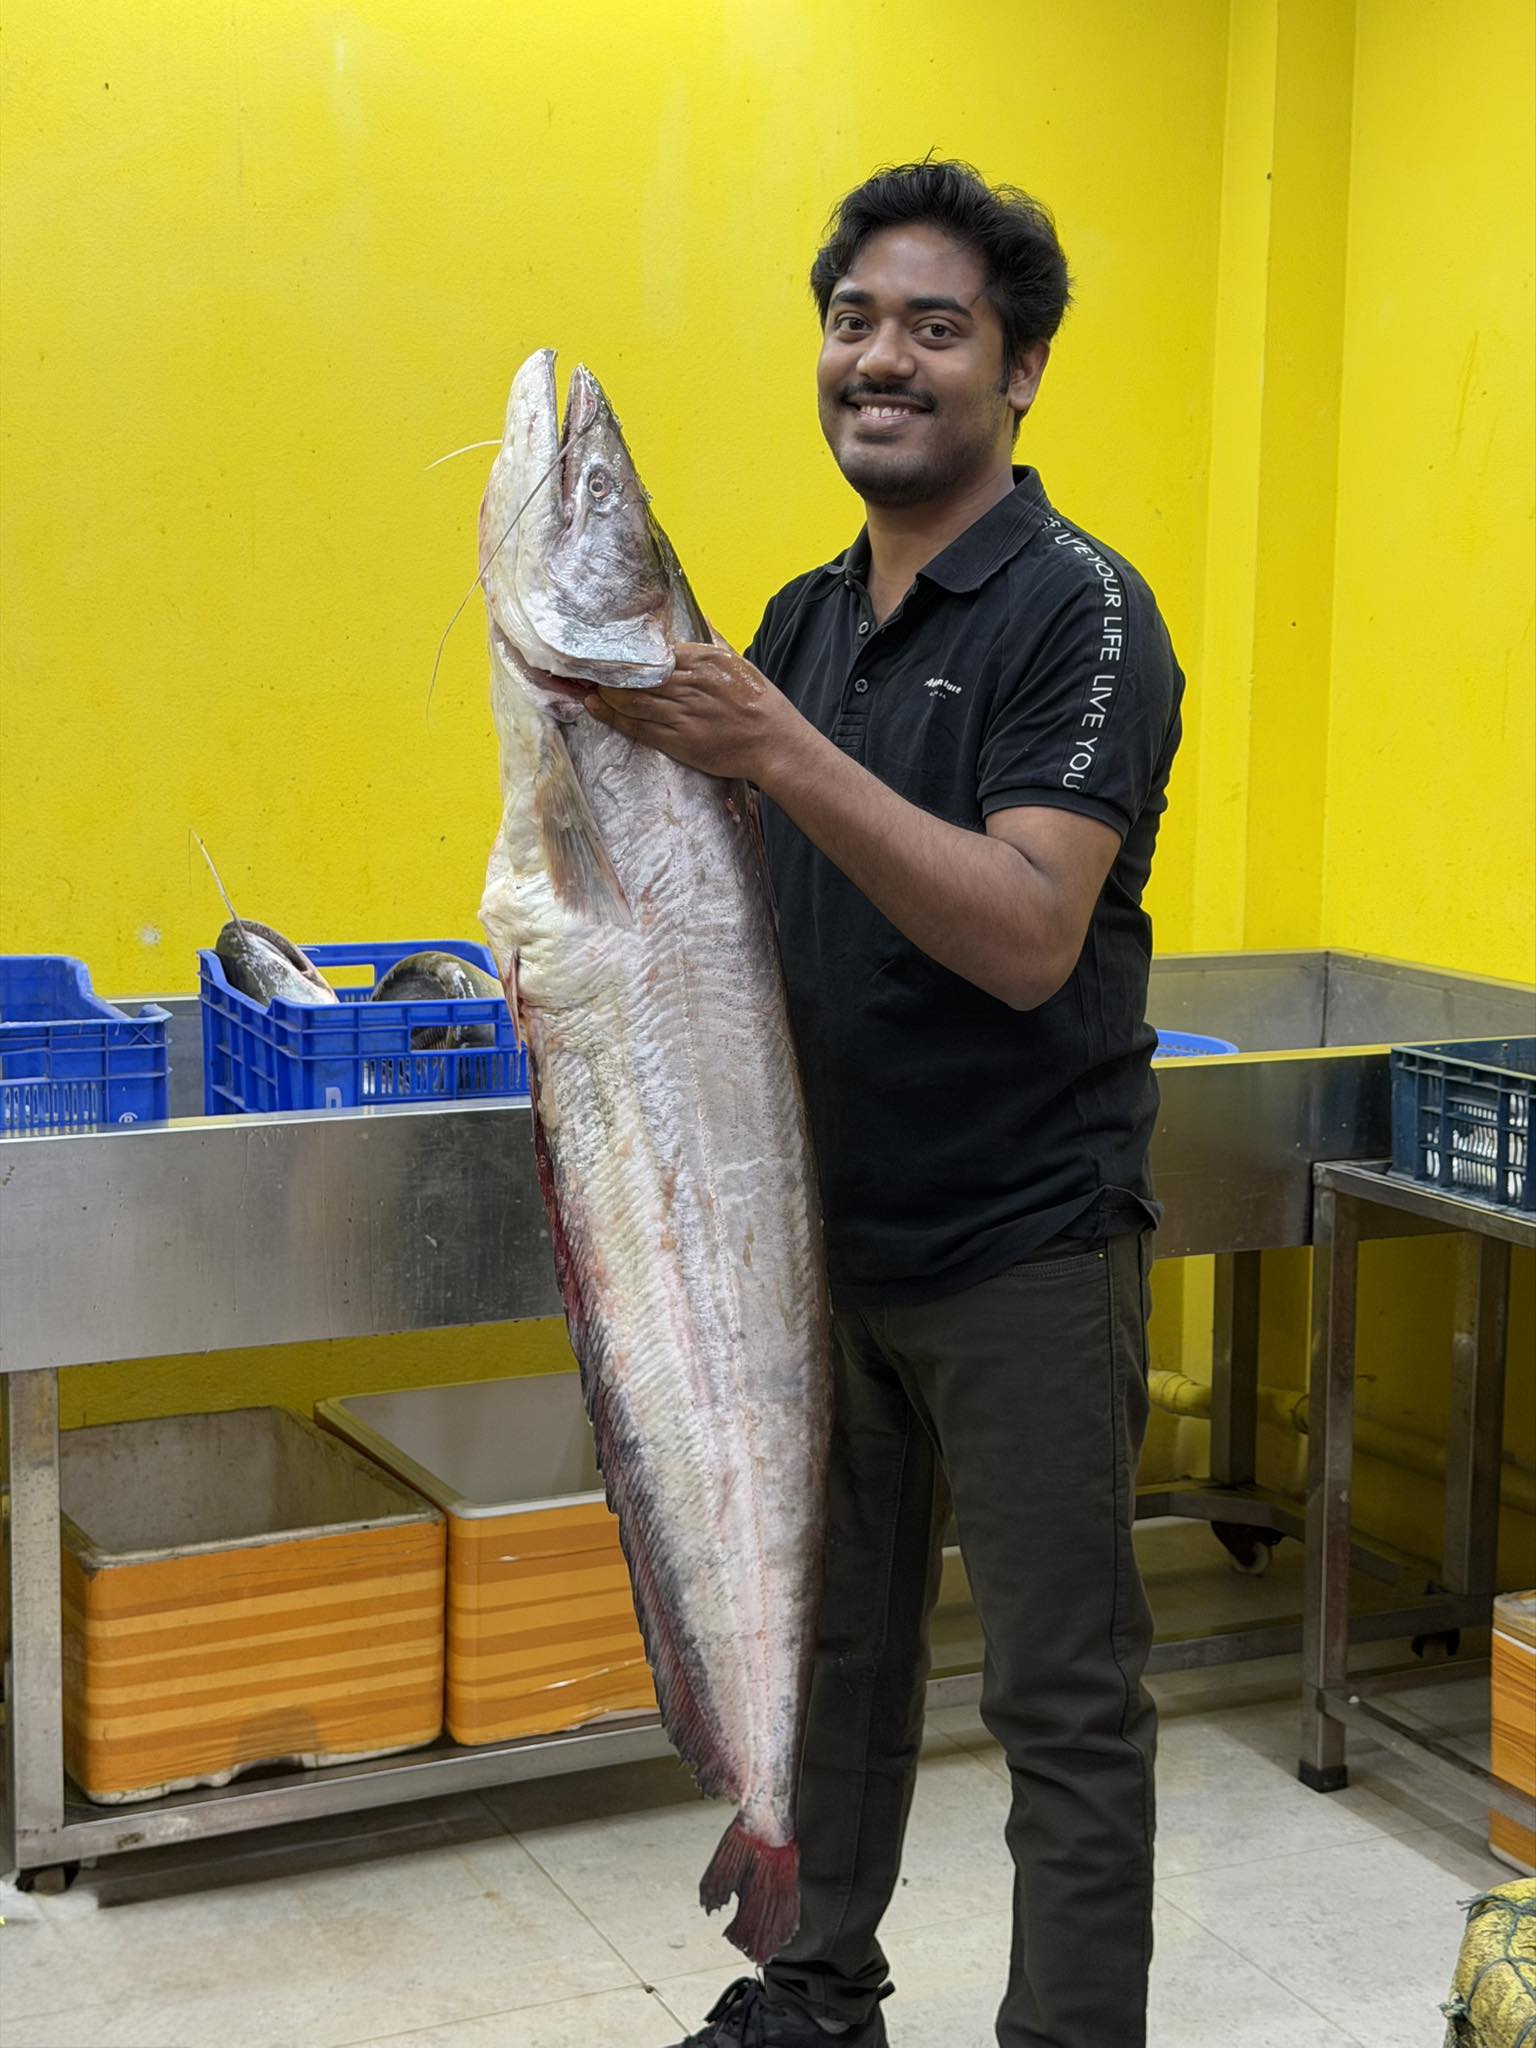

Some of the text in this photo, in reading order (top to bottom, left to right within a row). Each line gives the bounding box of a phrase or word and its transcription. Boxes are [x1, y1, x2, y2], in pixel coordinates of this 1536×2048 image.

[1087, 555, 1122, 608] YOUR
[1100, 615, 1123, 661] LIFE
[1081, 674, 1116, 729] LIVE
[1062, 736, 1099, 790] YOU
